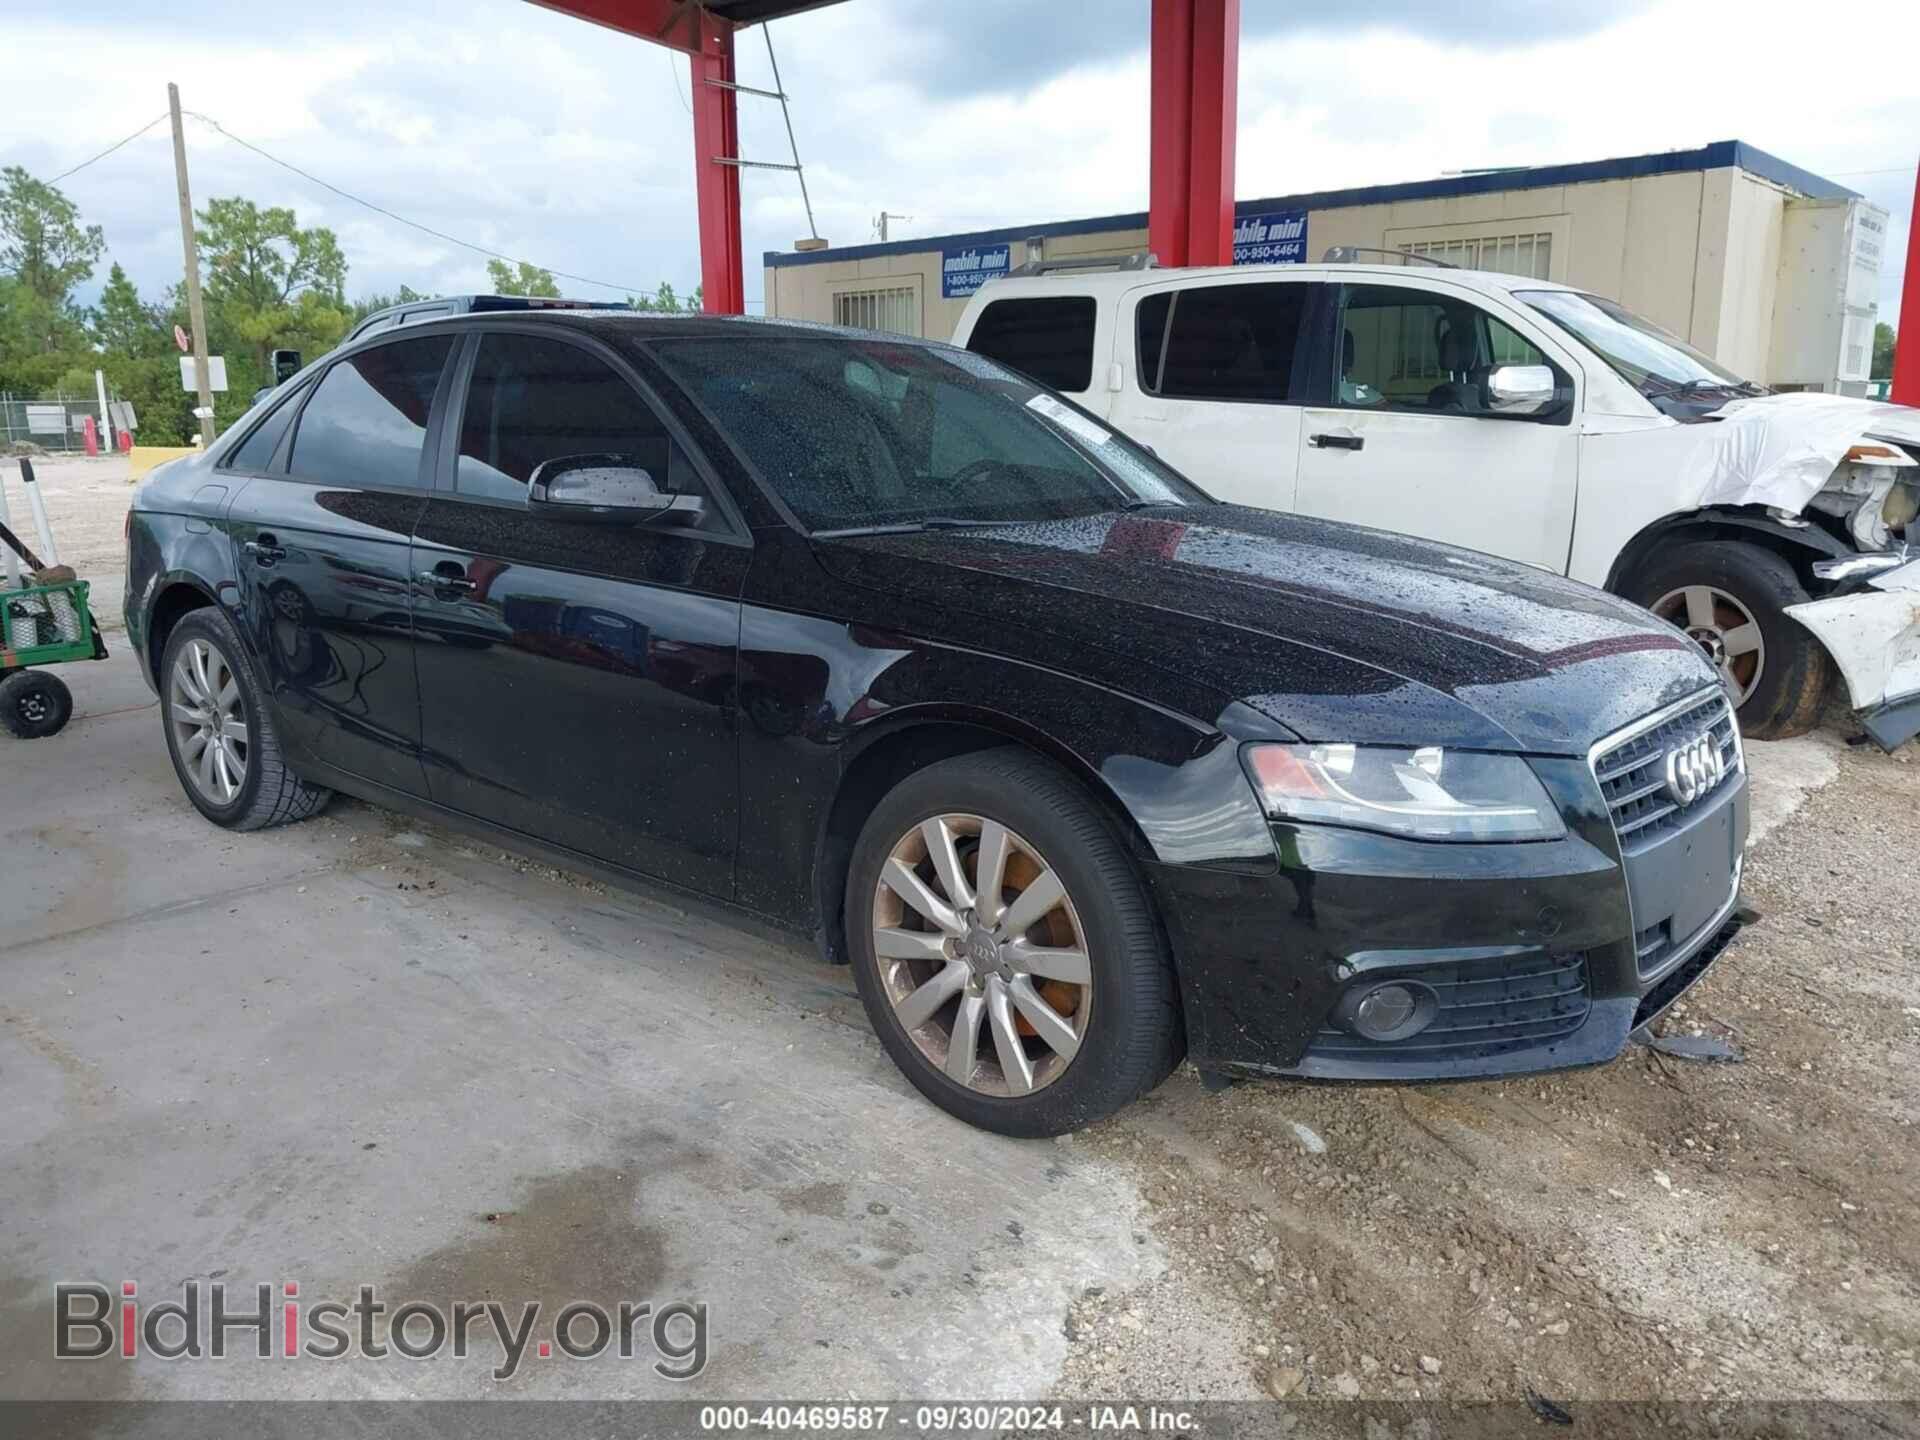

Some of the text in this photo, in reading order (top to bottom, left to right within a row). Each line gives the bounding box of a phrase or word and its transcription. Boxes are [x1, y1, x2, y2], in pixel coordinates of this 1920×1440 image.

[1233, 217, 1304, 244] obile mini
[944, 249, 1008, 272] mobile mini
[1234, 244, 1300, 260] 00-950-6464
